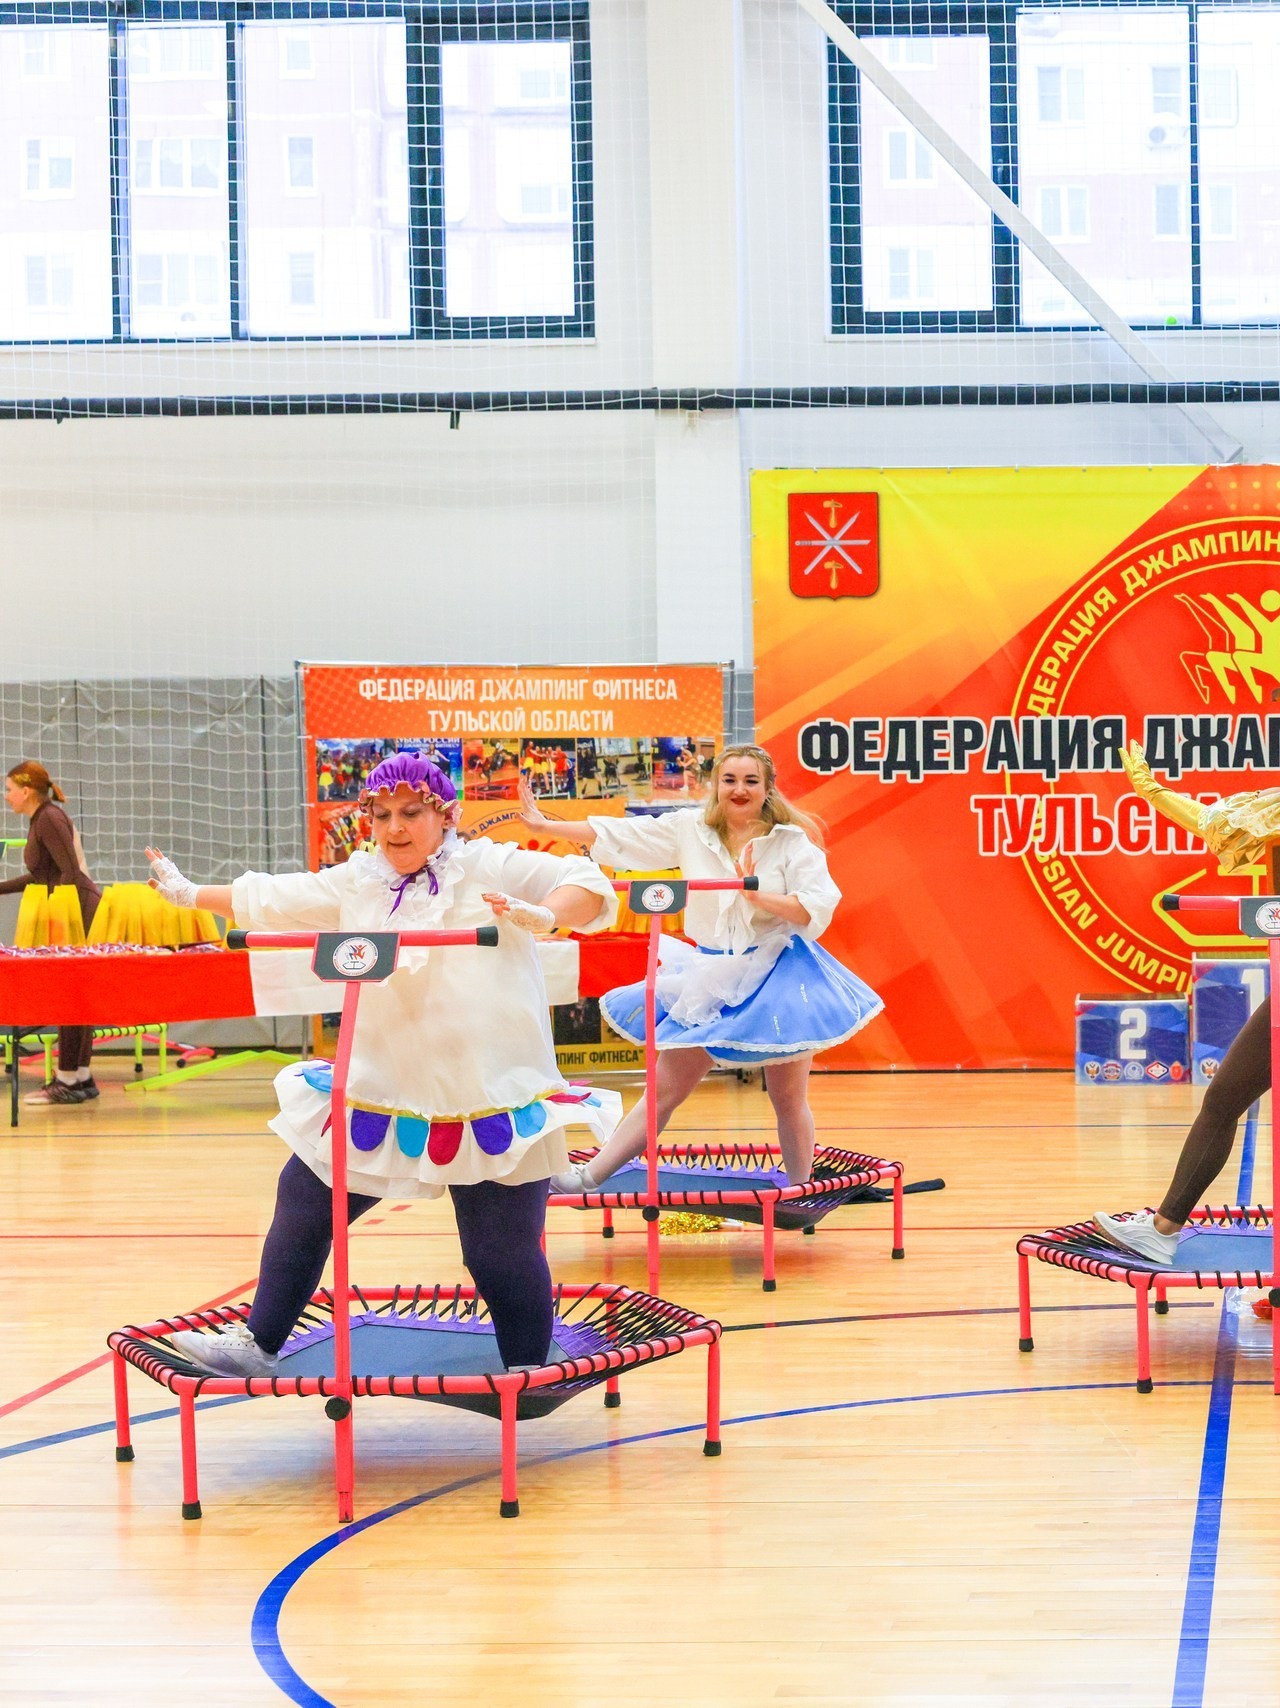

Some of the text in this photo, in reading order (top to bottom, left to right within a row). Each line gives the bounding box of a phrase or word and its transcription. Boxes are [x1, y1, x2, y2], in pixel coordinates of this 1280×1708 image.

[1027, 585, 1118, 718] ДЕРАЦИЯ
[358, 677, 678, 703] ФЕДЕРАЦИЯ ДЖАМПИНГ ФИТНЕСА
[428, 707, 614, 732] ТУЛЬСКОЙ ОБЛАСТИ
[799, 717, 1124, 781] ФЕДЕРАЦИЯ
[971, 795, 1219, 855] ТУЛЬСК
[1031, 828, 1194, 995] SSIAN JUMPI
[1240, 968, 1265, 1017] 1
[556, 1049, 644, 1065] ПИНГ ФИТНЕСА"
[1119, 1007, 1147, 1060] 2
